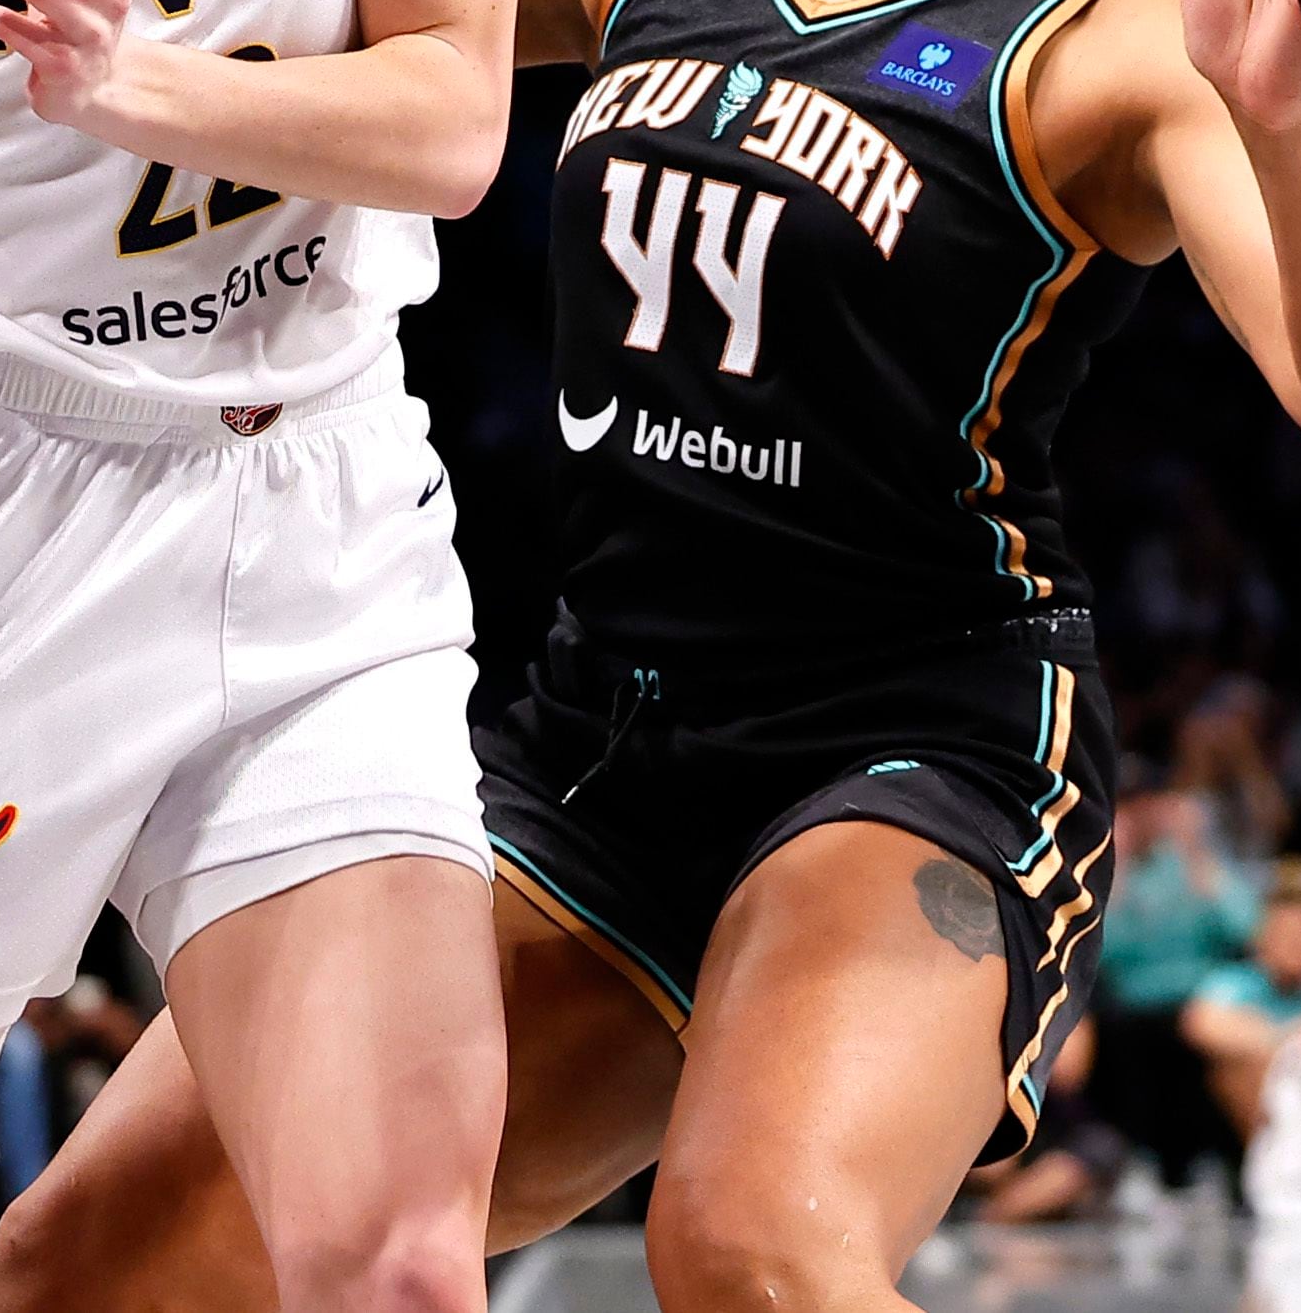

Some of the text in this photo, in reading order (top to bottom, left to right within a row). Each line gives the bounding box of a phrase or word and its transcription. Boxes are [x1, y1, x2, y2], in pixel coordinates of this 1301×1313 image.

[880, 61, 958, 97] BARCLAYS
[555, 57, 925, 262] NEW YORK
[61, 235, 328, 346] salesforce
[600, 156, 788, 379] 44
[632, 408, 803, 488] Webull
